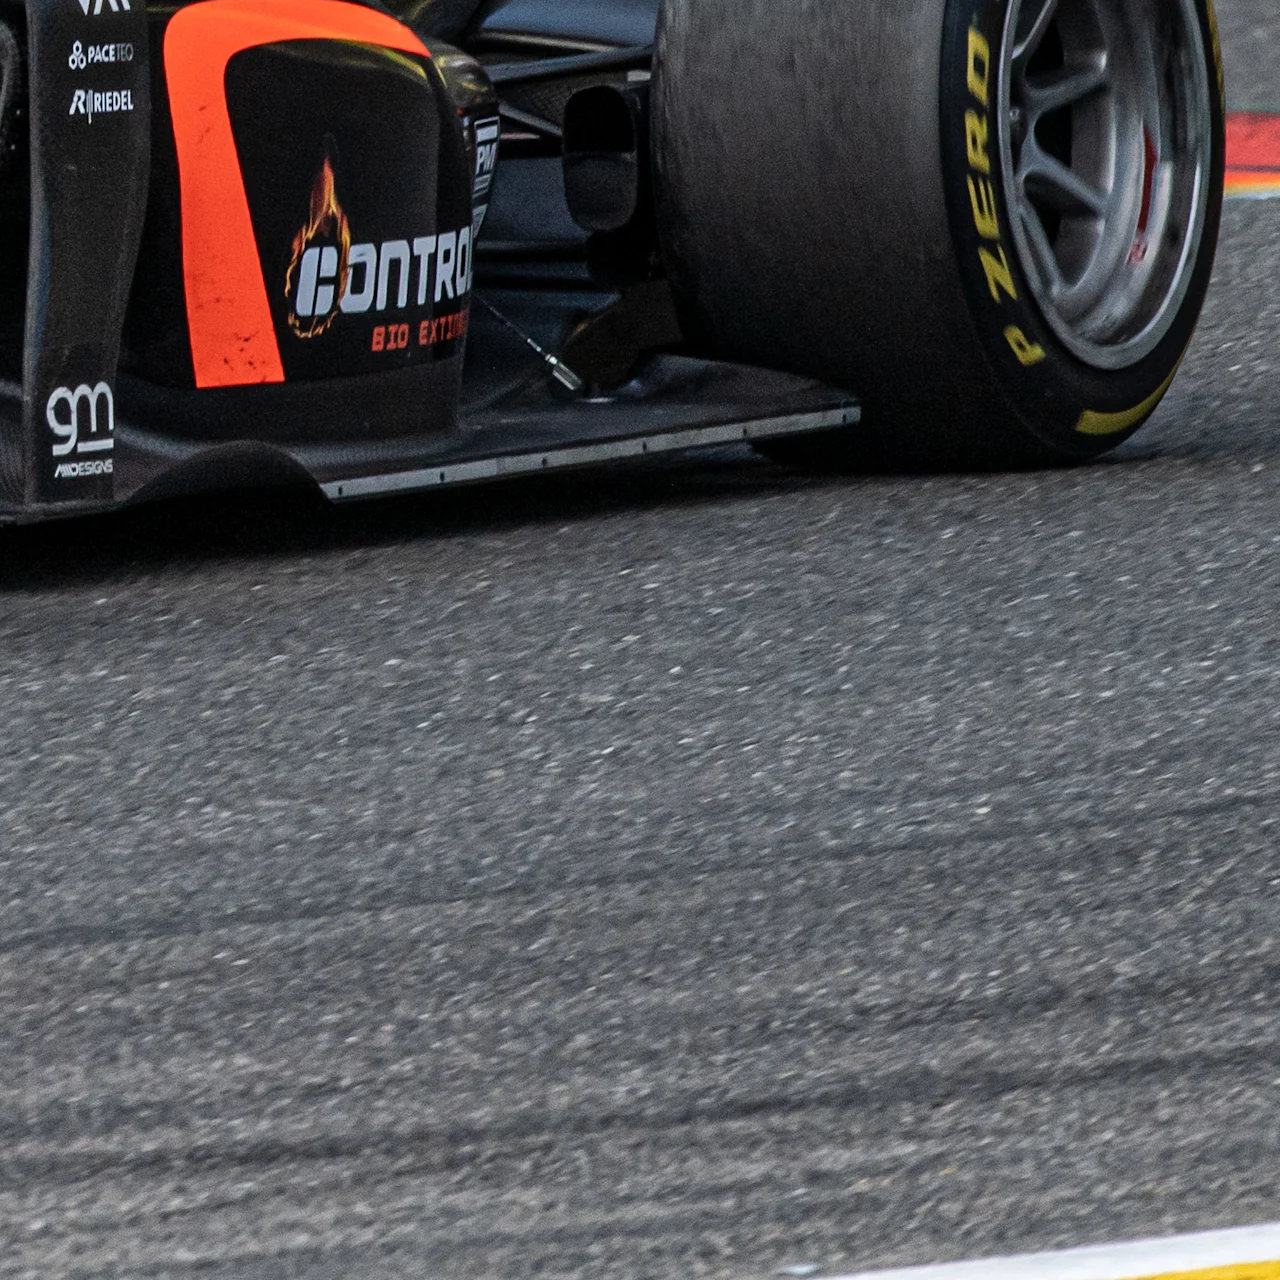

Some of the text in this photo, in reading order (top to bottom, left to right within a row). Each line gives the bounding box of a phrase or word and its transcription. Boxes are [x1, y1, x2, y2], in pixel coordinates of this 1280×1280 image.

[94, 88, 134, 113] RIEDEL
[964, 26, 1046, 367] P ZERO
[371, 323, 410, 353] BIO
